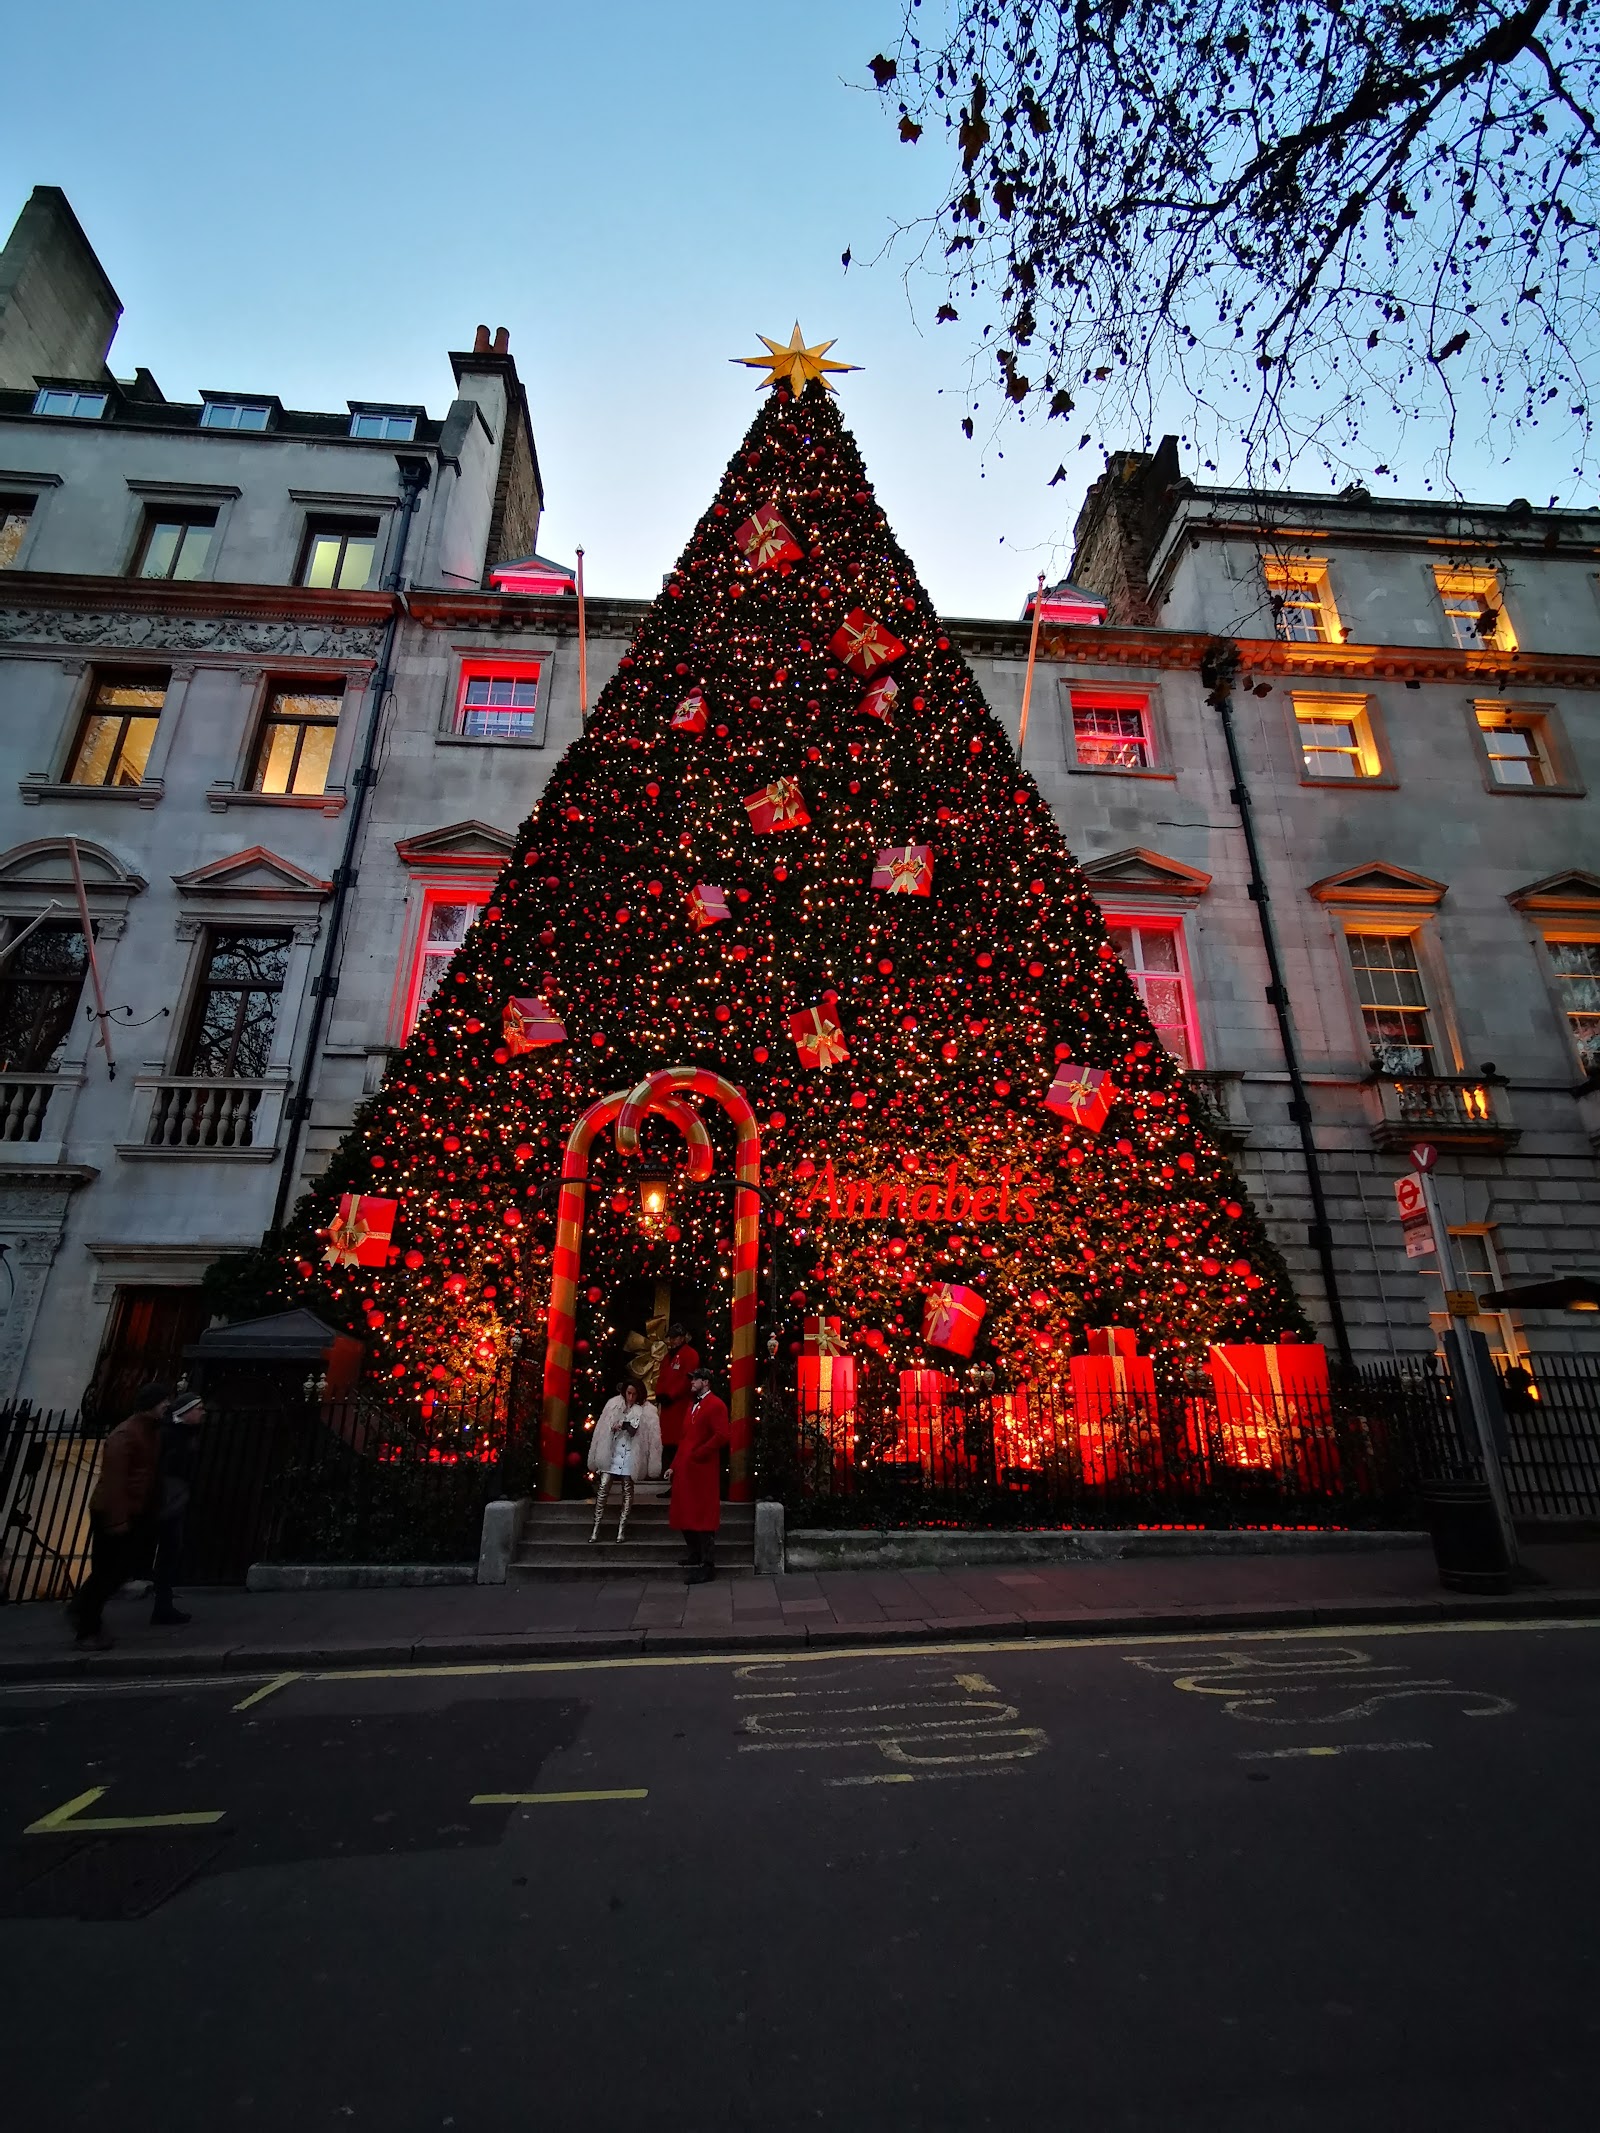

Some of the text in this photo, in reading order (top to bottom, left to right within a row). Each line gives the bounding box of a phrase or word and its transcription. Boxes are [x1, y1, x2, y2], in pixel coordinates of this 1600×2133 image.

[1412, 1146, 1430, 1166] V
[795, 1158, 1040, 1224] Annabel's
[1121, 1647, 1518, 1726] BUS
